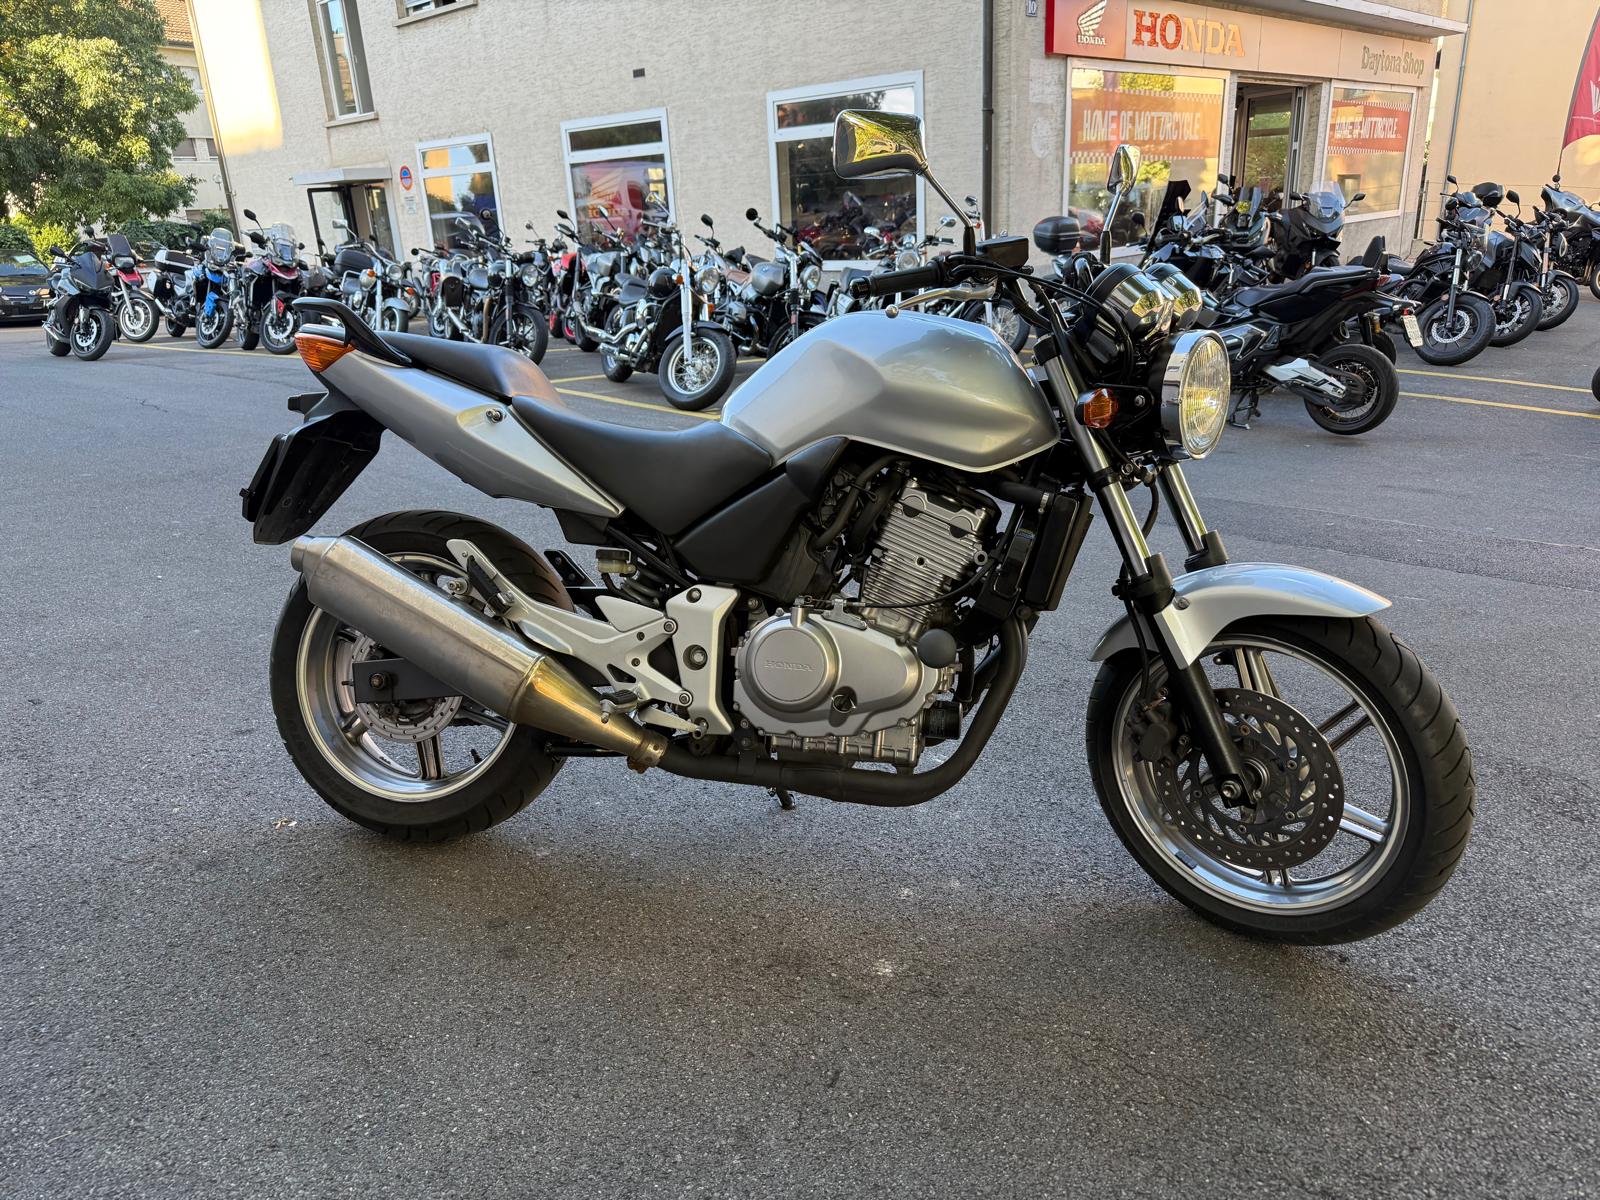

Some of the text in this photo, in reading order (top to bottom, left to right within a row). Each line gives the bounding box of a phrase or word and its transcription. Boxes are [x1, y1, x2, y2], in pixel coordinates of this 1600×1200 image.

[1077, 34, 1107, 46] HONDA
[1132, 9, 1246, 57] HONDA
[1361, 45, 1425, 79] Daytona Shop
[1083, 109, 1118, 142] HOME
[1119, 110, 1134, 141] OF
